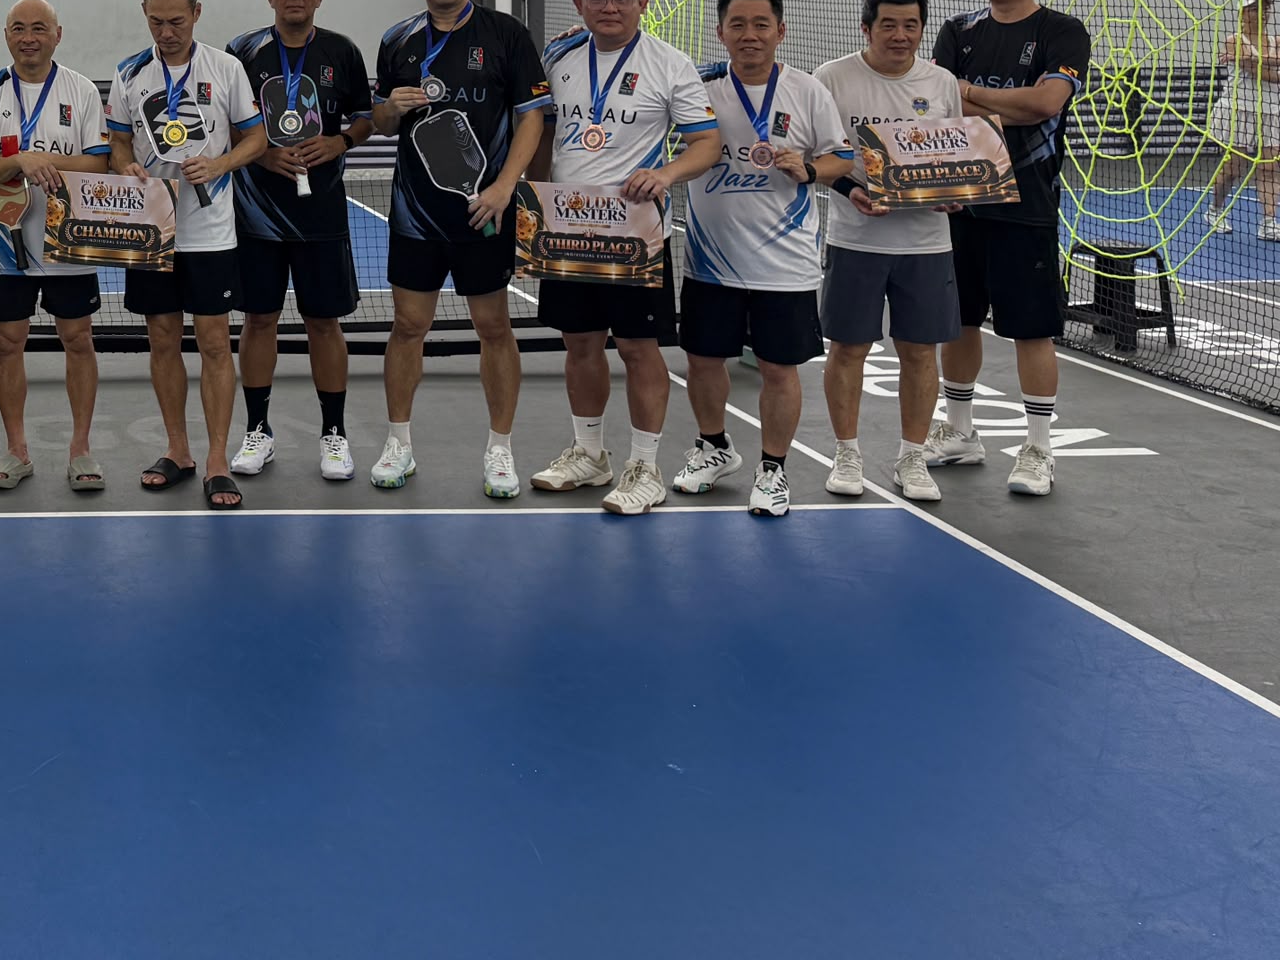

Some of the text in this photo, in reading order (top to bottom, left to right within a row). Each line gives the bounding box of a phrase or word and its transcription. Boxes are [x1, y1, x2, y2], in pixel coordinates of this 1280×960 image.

[898, 138, 969, 153] MASTERS
[705, 162, 770, 194] Jazz
[899, 165, 983, 182] 4TH PLACE
[81, 195, 144, 210] MASTERS
[555, 206, 627, 222] MASTERS
[72, 224, 147, 241] CHAMPION
[546, 238, 633, 254] THIRD PLACE
